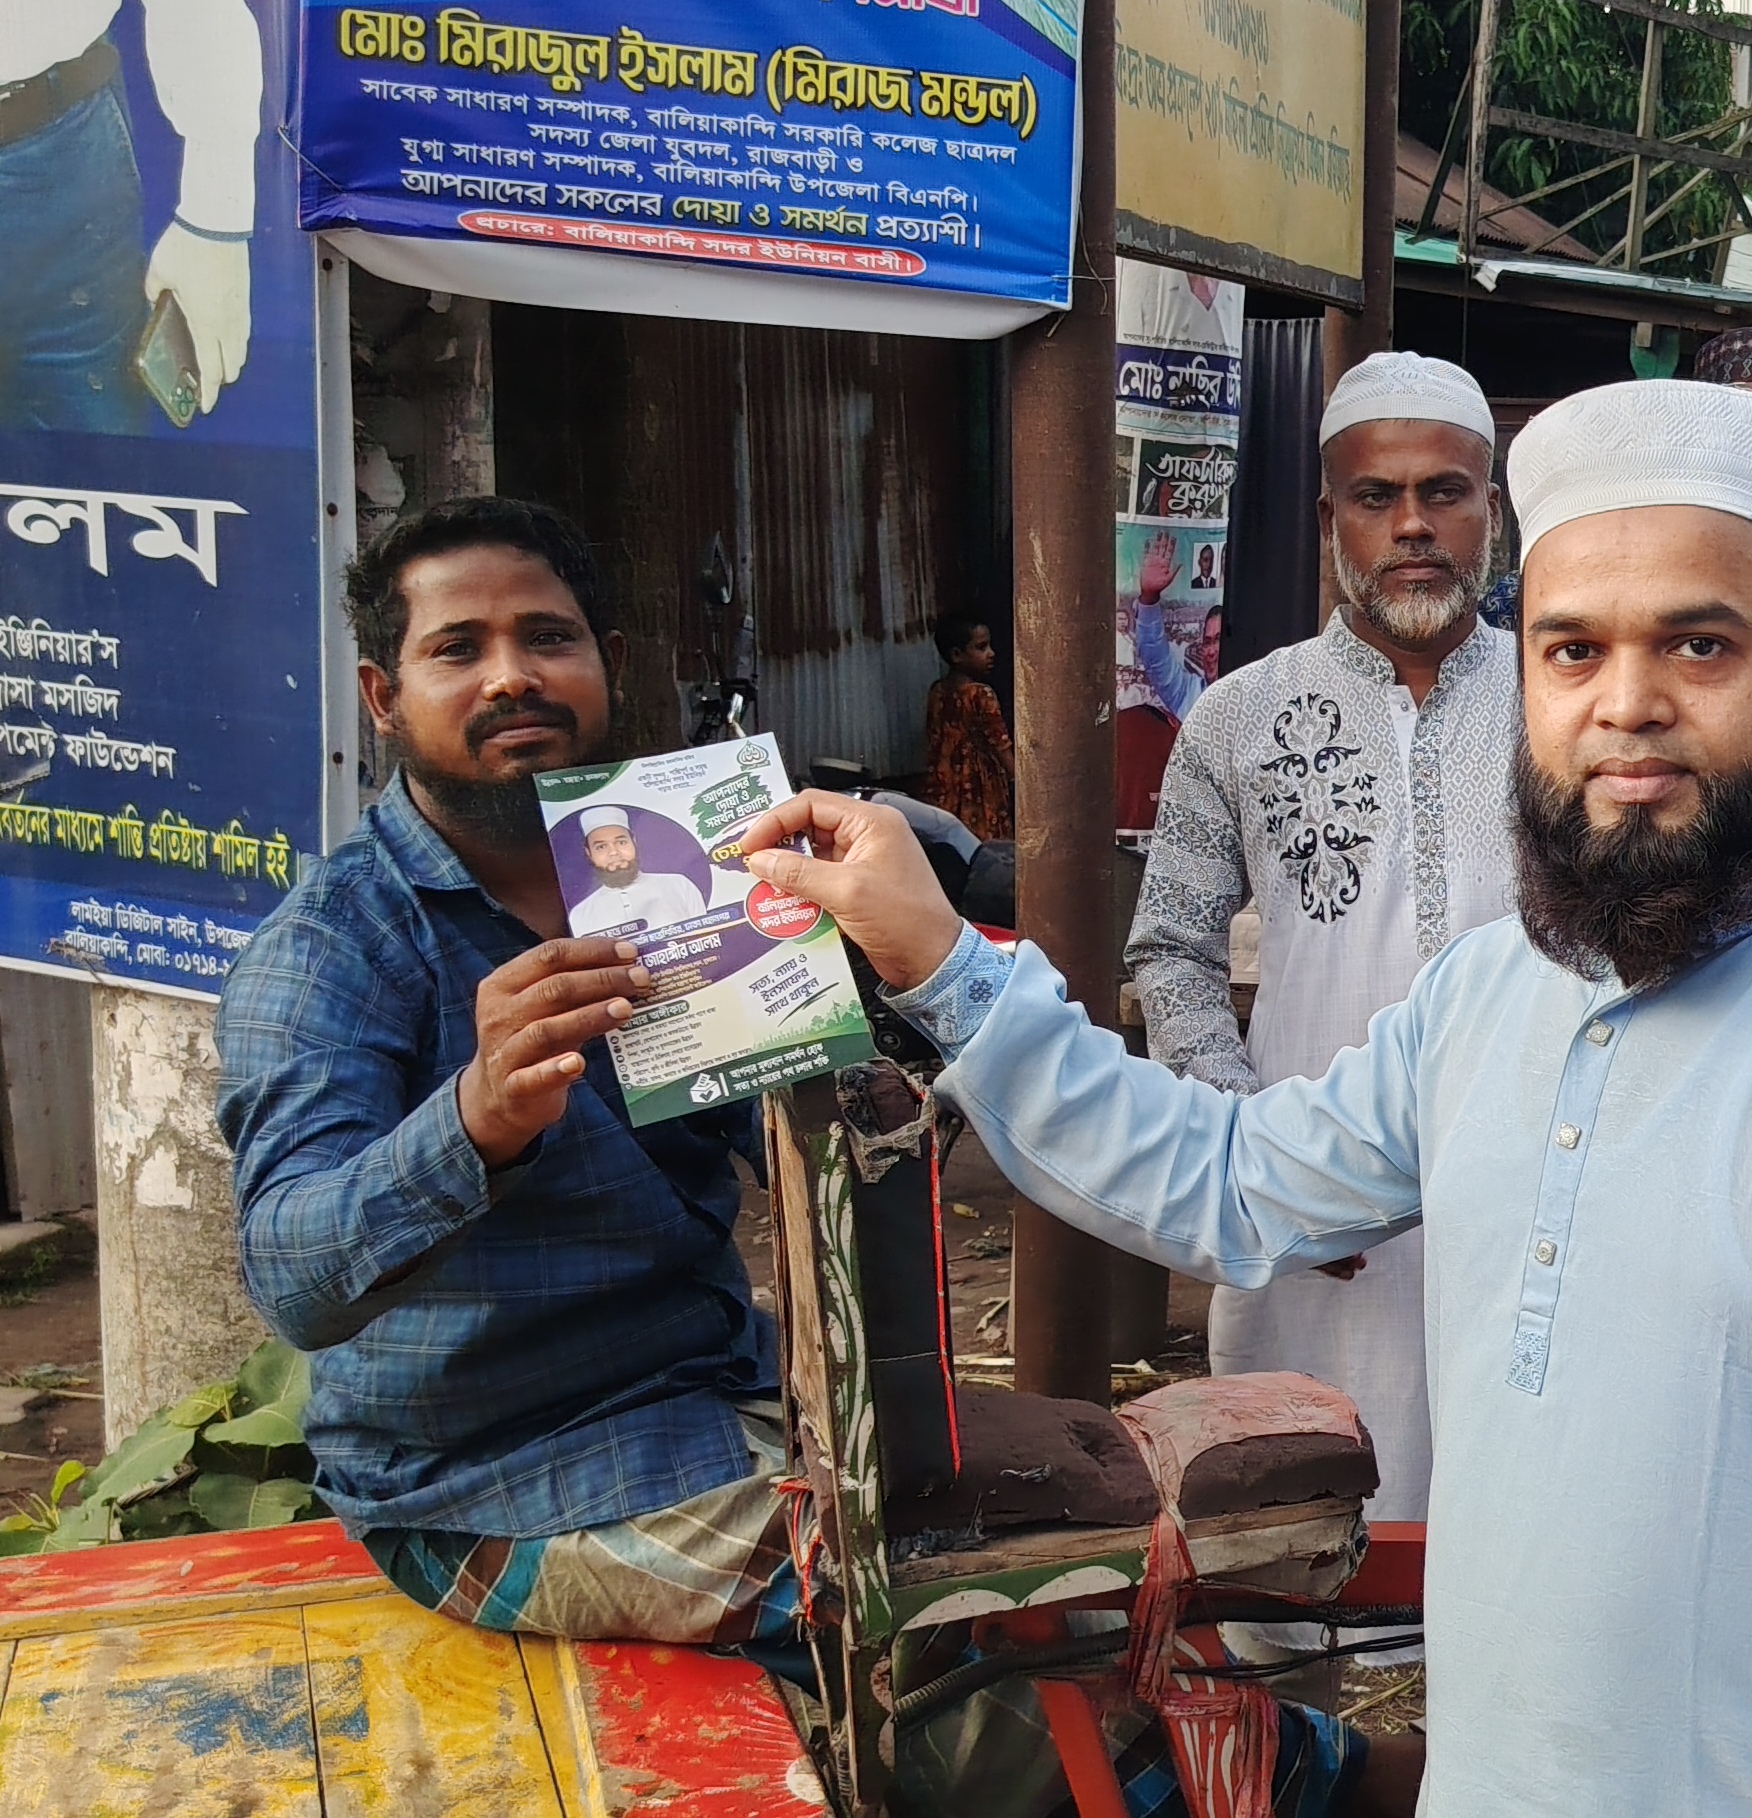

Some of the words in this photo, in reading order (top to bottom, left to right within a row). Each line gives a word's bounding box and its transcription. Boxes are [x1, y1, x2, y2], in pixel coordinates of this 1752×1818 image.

[340, 8, 425, 62] মোঃ
[437, 7, 610, 92] মিরাজুল
[618, 25, 758, 97] ইসলাম
[767, 45, 914, 117] (মিরাজ
[360, 79, 438, 106] সাবেক
[447, 87, 528, 115] সাধারণ
[536, 97, 637, 130] সম্পাদক,
[646, 105, 775, 140] বালিয়াকান্দি
[784, 122, 864, 149] সরকারি
[870, 135, 937, 156] কলেজ
[943, 141, 1017, 166] ছাত্রদল
[527, 124, 592, 147] সদস্য
[600, 132, 657, 155] জেলা
[664, 136, 738, 166] যুবদল,
[746, 146, 839, 173] রাজবাড়ী
[846, 156, 863, 173] ও
[400, 138, 445, 164] যুগ্ম
[450, 142, 536, 169] সাধারণ
[541, 152, 644, 183] সম্পাদক,
[652, 159, 782, 193] বালিয়াকান্দি
[787, 170, 879, 202] উপজেলা
[400, 169, 548, 206] আপনাদের
[554, 184, 663, 216] সকলের
[672, 195, 742, 226] দোয়া
[749, 203, 770, 226] ও
[779, 206, 868, 236] সমর্থন
[564, 224, 696, 251] বালিয়াকান্দি
[704, 239, 752, 257] সদর
[759, 240, 846, 265] ইউনিয়ন
[1119, 359, 1164, 400] মোঃ
[39, 674, 122, 721] মসজিদ
[62, 726, 176, 779] ফাউন্ডেশন
[701, 776, 750, 803] আপনাদের
[741, 789, 750, 801] ও
[54, 806, 104, 853] মাধ্যমে
[107, 803, 144, 859] শান্তি
[211, 819, 261, 880] শামিল
[115, 902, 164, 937] ডিজিটাল
[204, 918, 254, 950] উপজেল
[759, 915, 780, 928] সদর
[779, 907, 815, 924] ইউনিয়ন
[64, 925, 133, 965] বালিয়াকান্দি,
[644, 941, 688, 969] জাহাঙ্গীর
[689, 932, 722, 954] আলম
[749, 975, 775, 995] সত্য,
[773, 957, 798, 977] ন্যায়
[799, 953, 808, 963] ও
[760, 967, 810, 1002] ইনসাফের
[765, 997, 789, 1016] সাথে
[789, 977, 820, 1000] থাকুন
